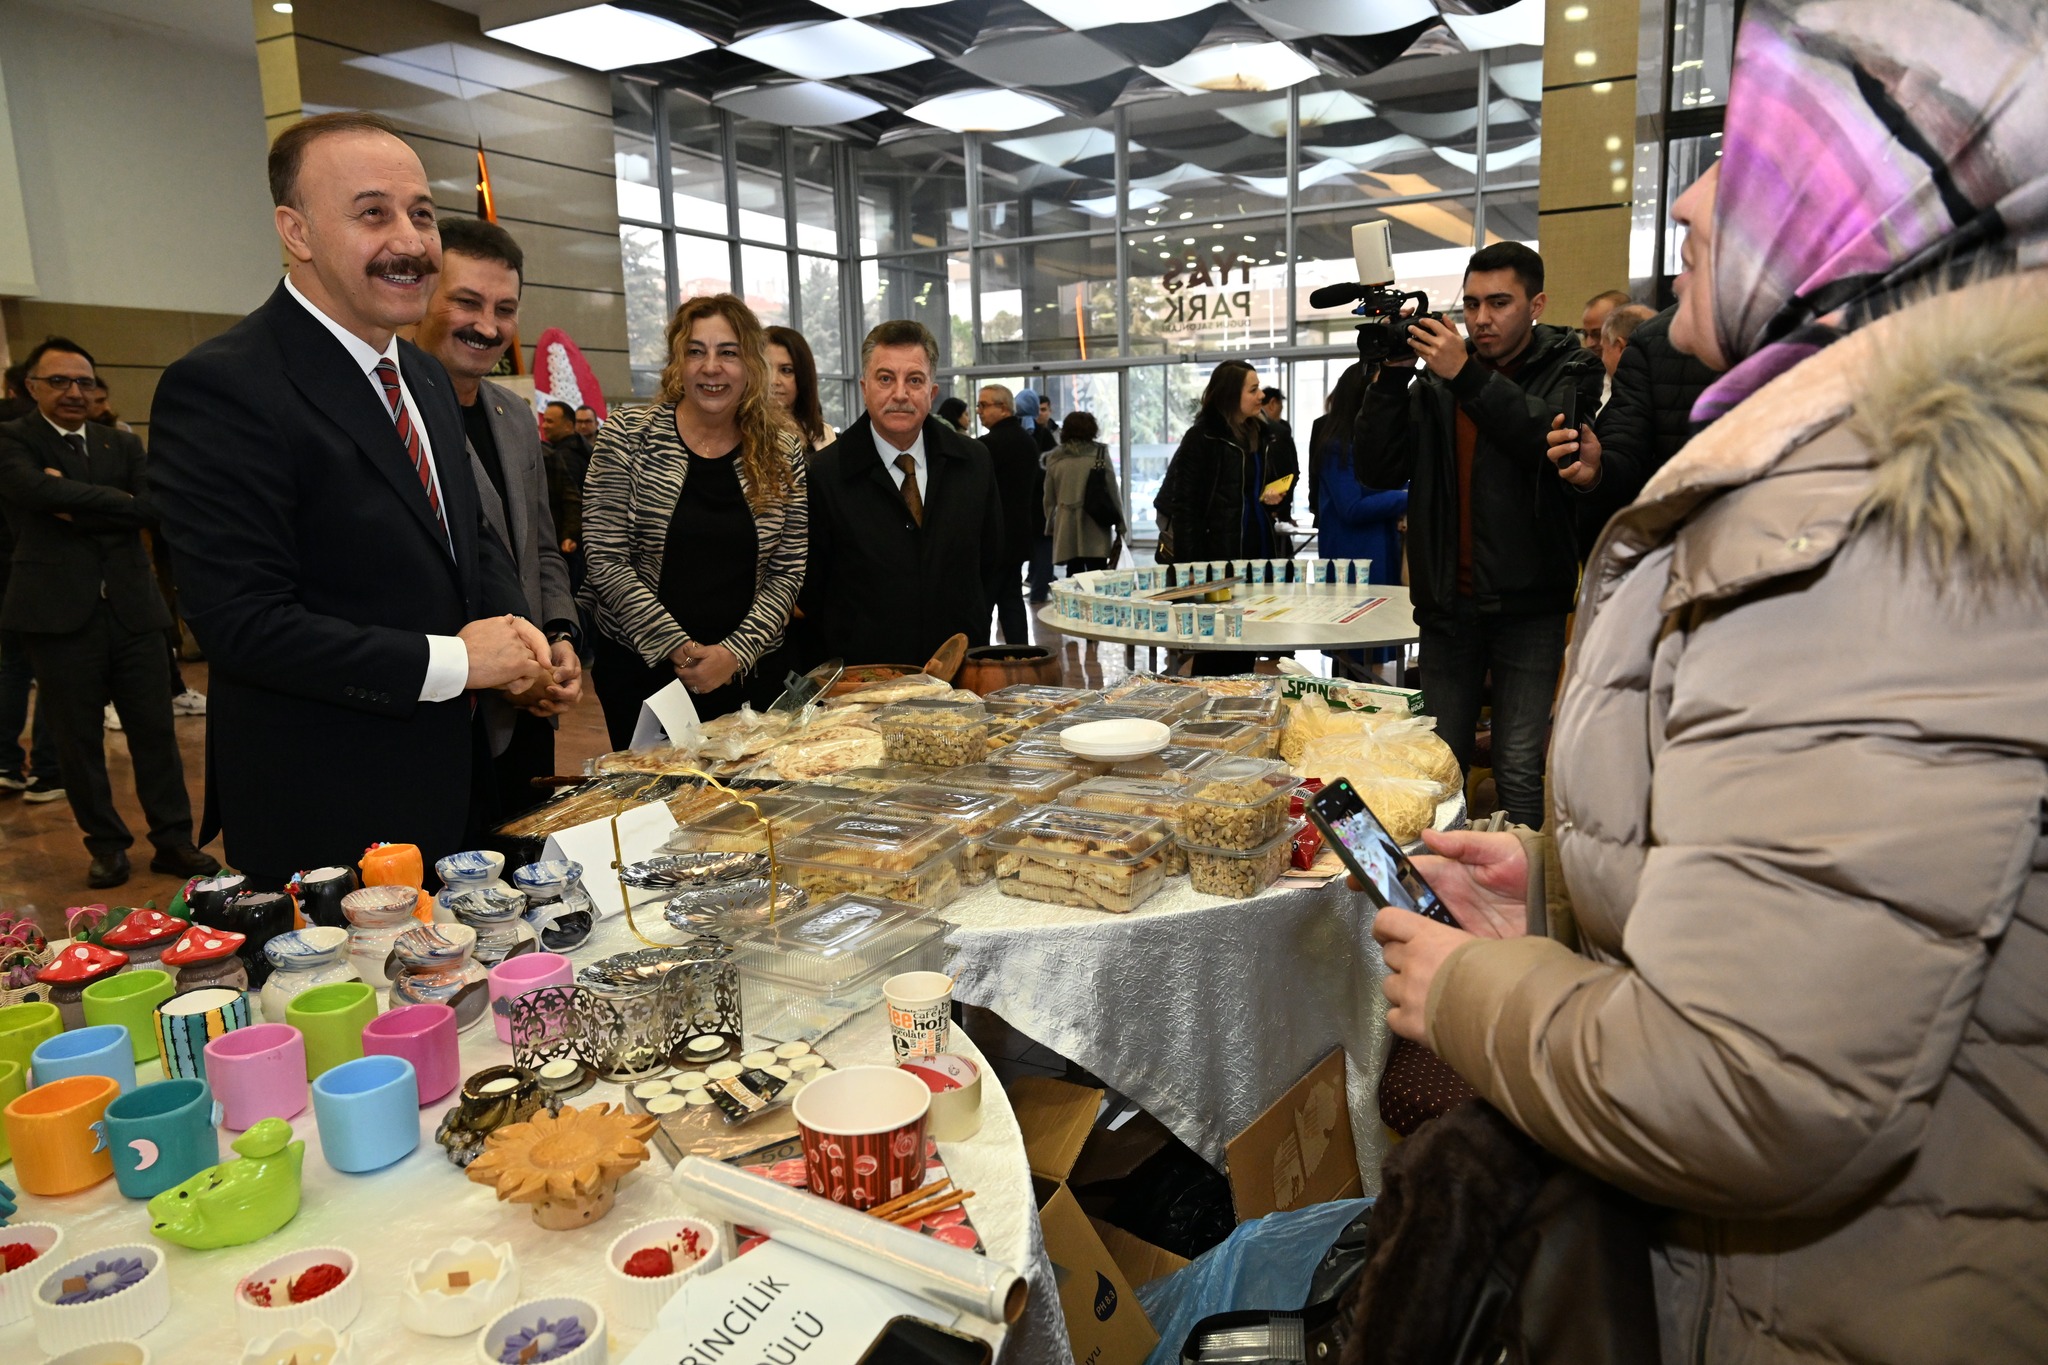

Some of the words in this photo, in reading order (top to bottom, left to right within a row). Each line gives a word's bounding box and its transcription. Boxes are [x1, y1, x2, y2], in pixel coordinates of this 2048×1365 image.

[1287, 680, 1328, 700] SPON
[914, 1016, 944, 1031] hot
[761, 1145, 794, 1163] 50
[1096, 1301, 1107, 1316] PH
[755, 1310, 824, 1365] ÜLÜ
